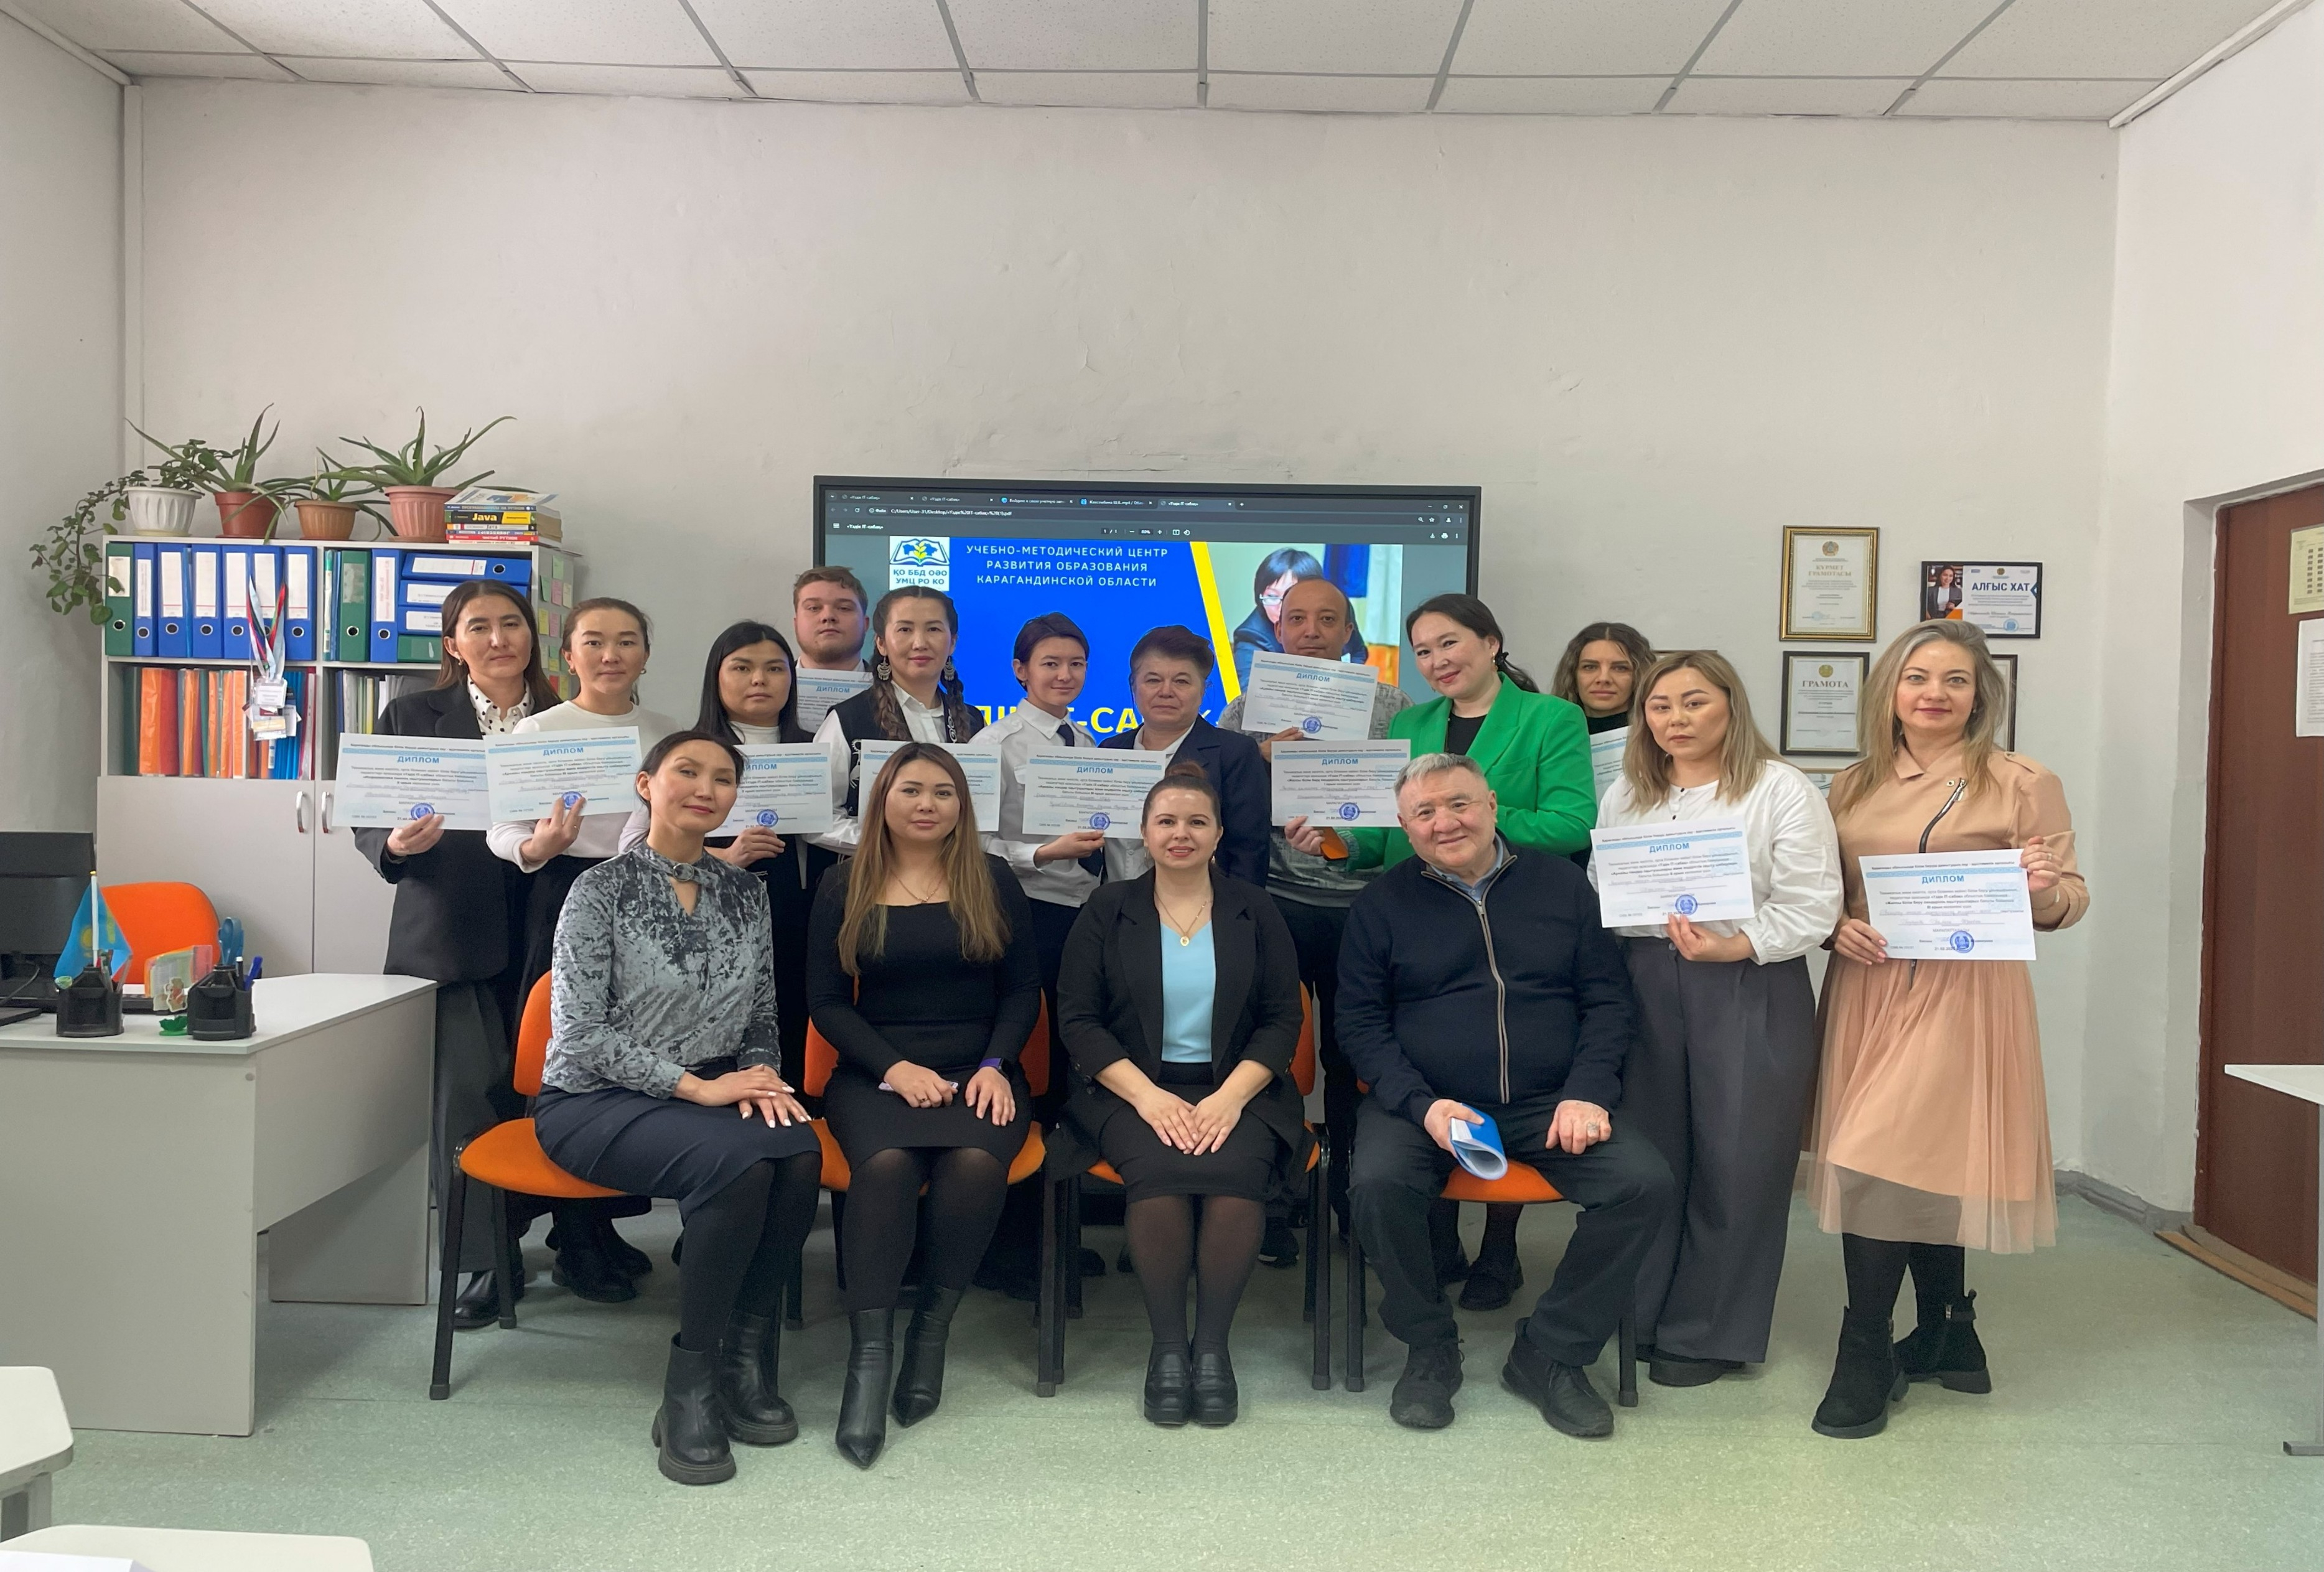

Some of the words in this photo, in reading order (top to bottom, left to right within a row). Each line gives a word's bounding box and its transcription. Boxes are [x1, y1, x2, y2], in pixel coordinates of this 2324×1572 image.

[472, 513, 497, 521] Java
[966, 545, 1122, 557] УЧЕБНО-МЕТОДИЧЕСКИЙ
[1128, 548, 1168, 558] ЦЕНТР
[987, 561, 1051, 570] РАЗВИТИЯ
[1057, 562, 1147, 571] ОБРАЗОВАНИЯ
[977, 575, 1093, 586] КАРАГАНДИНСКОЙ
[1098, 578, 1157, 587] ОБЛАСТИ
[1972, 582, 2007, 591] АЛҒЫС
[2010, 582, 2030, 591] ХАТ
[1296, 673, 1330, 682] ДИПЛОМ
[816, 685, 851, 693] ДИПЛОМ
[543, 747, 584, 756] ДИПЛОМ
[397, 756, 440, 764] ДИПЛОМ
[1649, 843, 1690, 853] ДИПЛОМ
[1921, 875, 1964, 884] ДИПЛОМ
